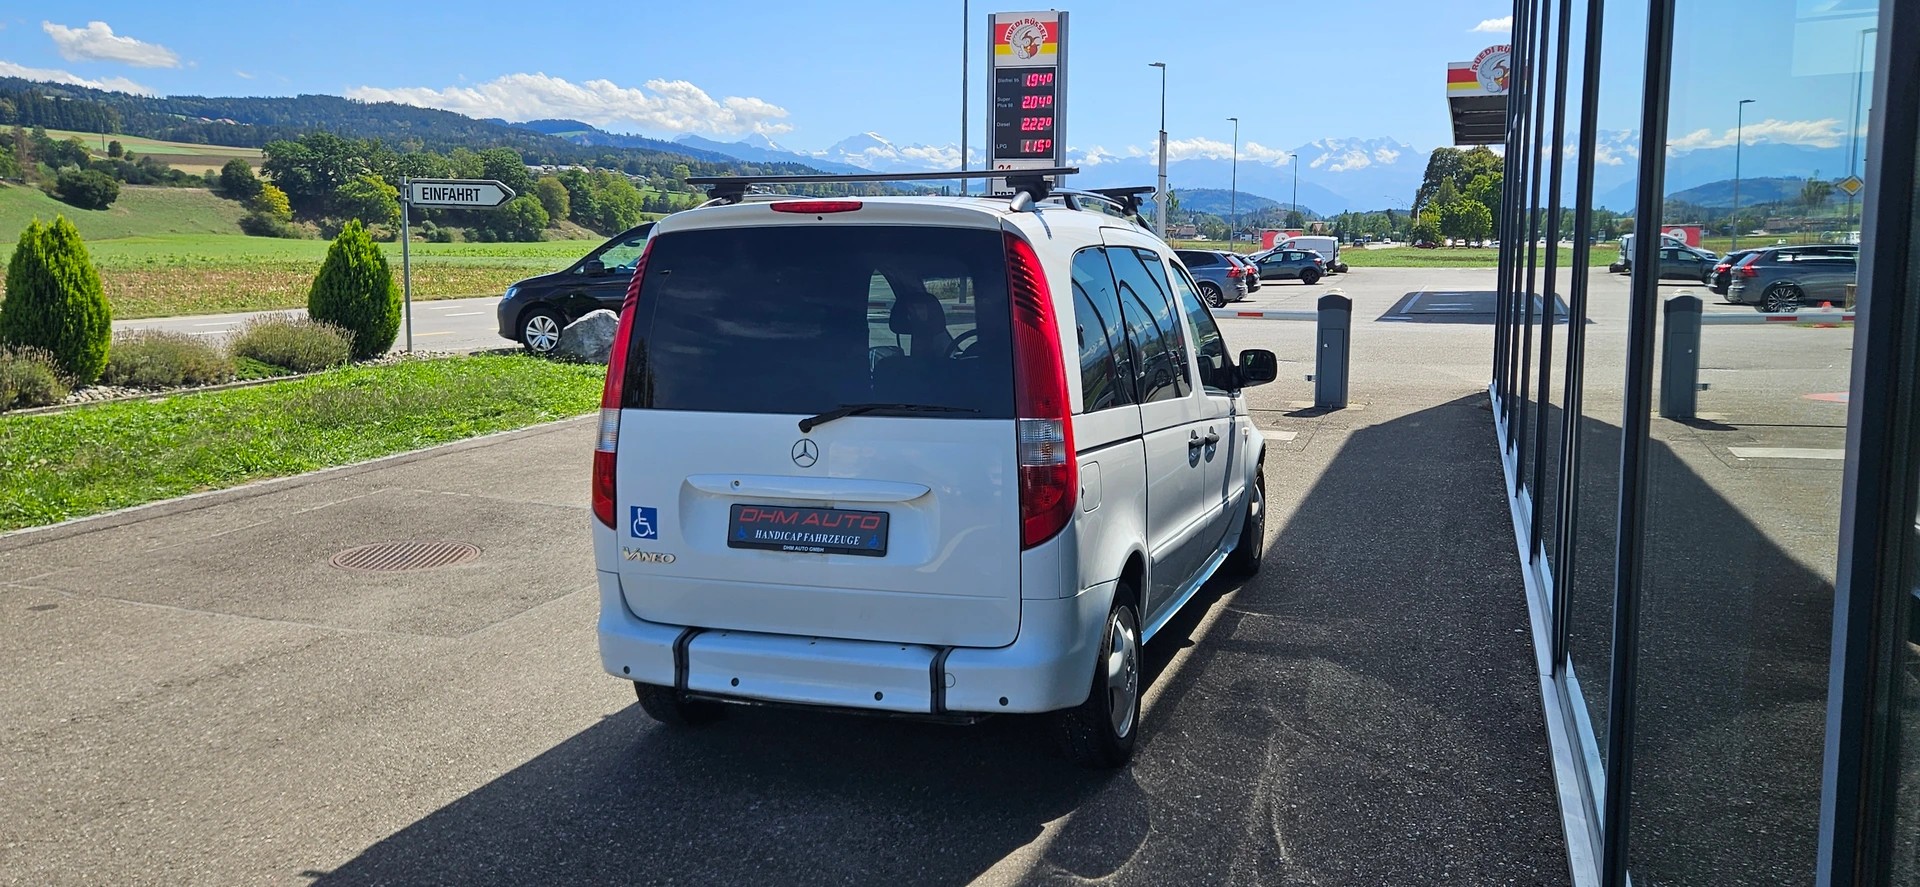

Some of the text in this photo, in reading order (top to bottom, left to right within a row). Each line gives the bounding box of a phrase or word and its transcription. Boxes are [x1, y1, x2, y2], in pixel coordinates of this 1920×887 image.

[1006, 18, 1047, 40] RUEDI RÜSSEL
[1472, 47, 1495, 70] RUEDI
[422, 187, 481, 202] EINFAHRT
[801, 512, 881, 530] AUTO
[755, 529, 861, 546] HANDICAP FAHRZEUGE
[623, 546, 676, 564] VANEO
